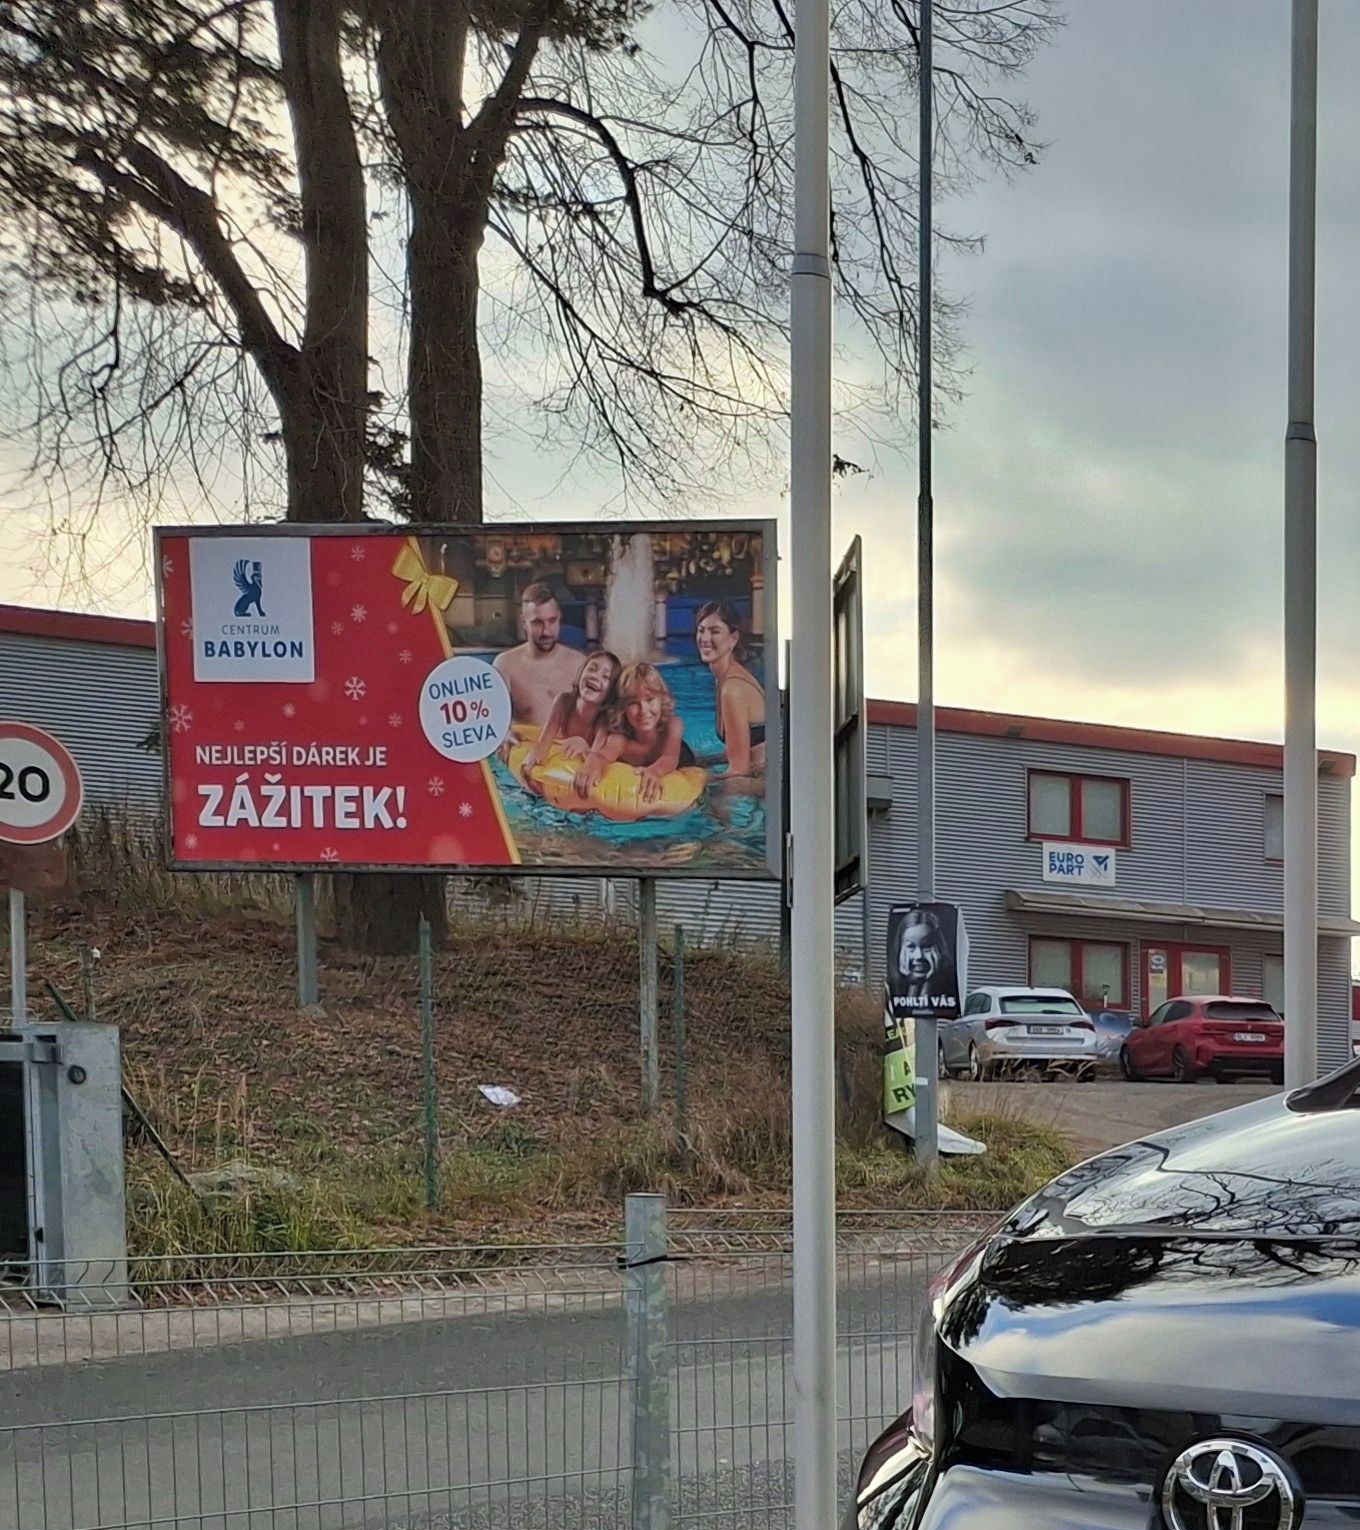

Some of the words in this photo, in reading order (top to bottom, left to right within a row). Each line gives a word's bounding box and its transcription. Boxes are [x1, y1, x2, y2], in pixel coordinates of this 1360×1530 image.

[221, 624, 280, 636] CENTRUM
[204, 640, 303, 658] BABYLON
[428, 672, 494, 700] ONLINE
[441, 723, 497, 748] SLEVA
[196, 741, 288, 766] NEJLEPŠÍ
[292, 742, 361, 766] DÁREK
[364, 746, 388, 766] JE
[197, 771, 408, 829] ZÁŽITEK!
[1049, 851, 1085, 865] EURO
[1049, 863, 1085, 876] PART
[931, 994, 957, 1007] VÁS
